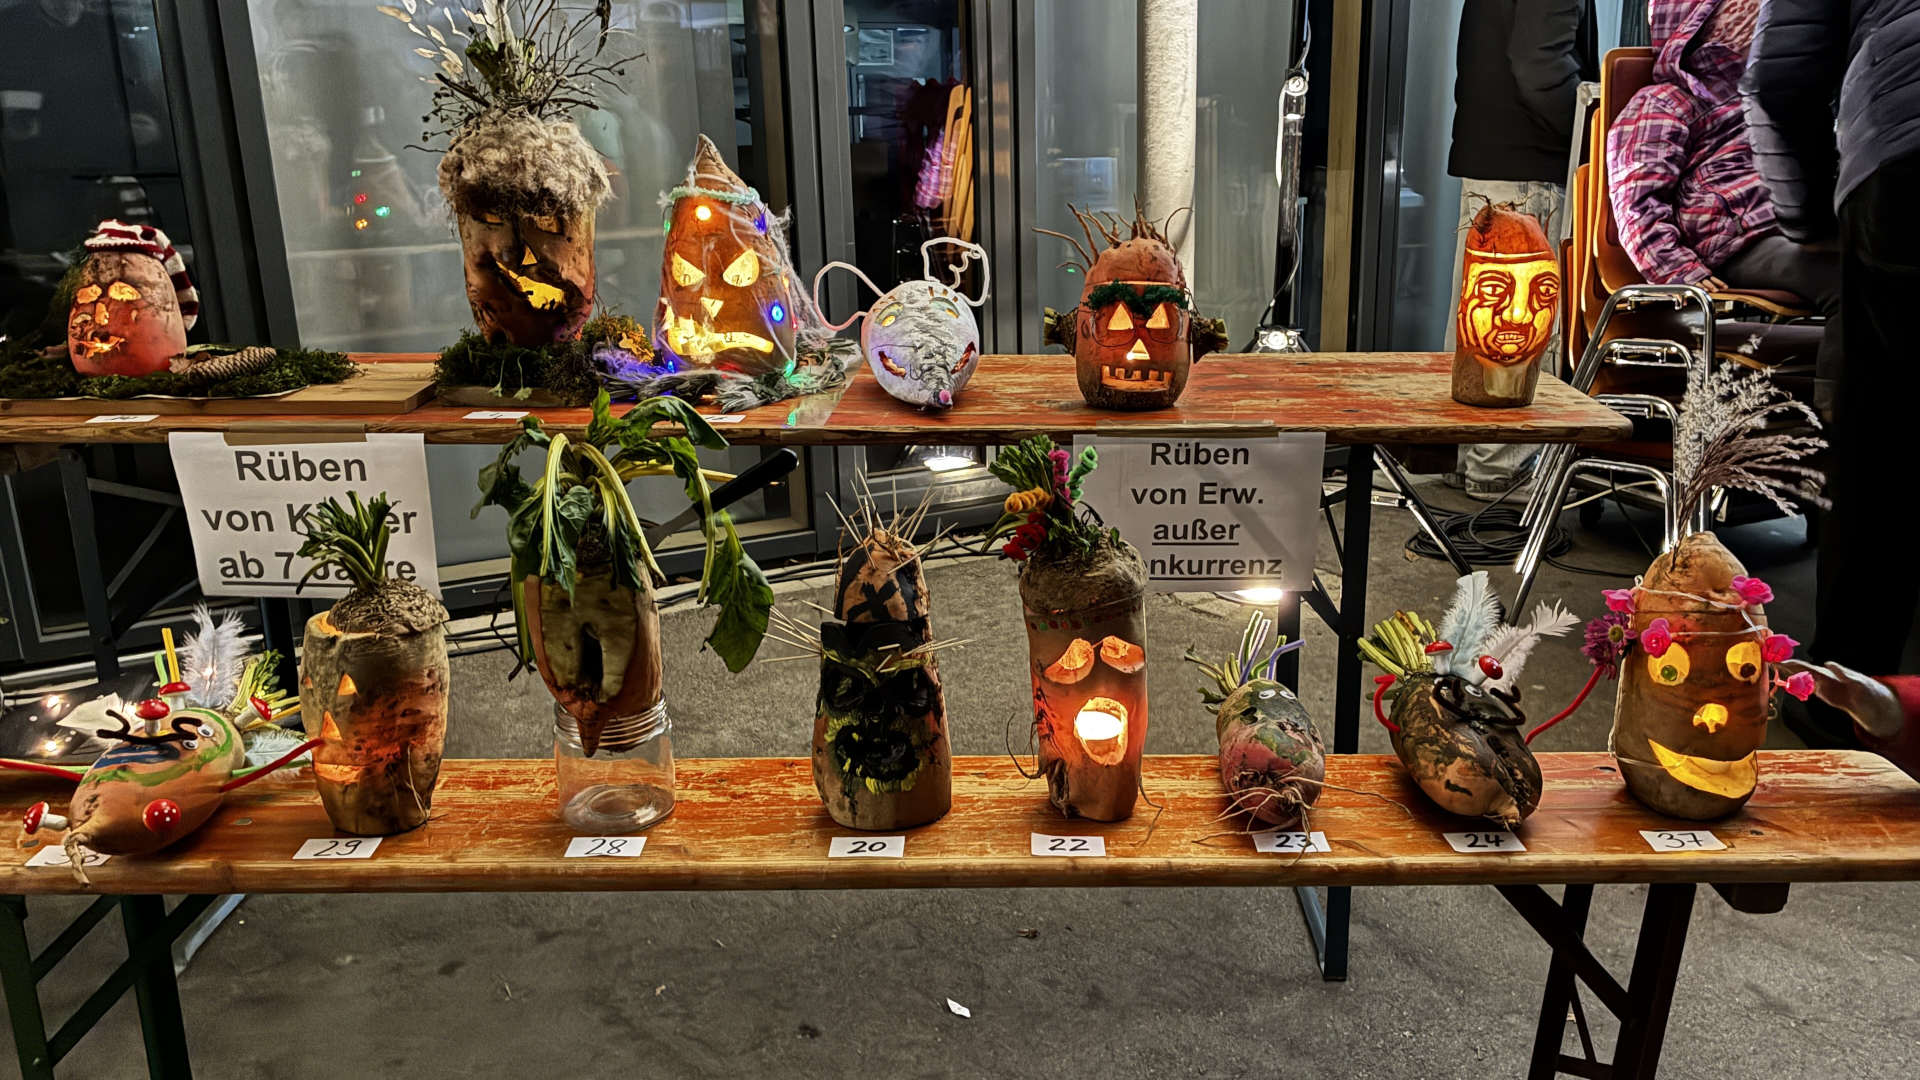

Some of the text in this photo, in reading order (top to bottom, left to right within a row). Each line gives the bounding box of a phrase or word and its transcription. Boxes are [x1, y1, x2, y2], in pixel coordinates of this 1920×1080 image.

[1150, 442, 1249, 465] Rüben
[234, 450, 367, 482] Rüben
[1131, 482, 1264, 505] von Erw.
[201, 503, 418, 534] von Ker
[1152, 518, 1241, 541] außer
[219, 551, 265, 580] ab
[274, 552, 295, 580] 7
[312, 839, 363, 857] 29
[584, 838, 629, 856] 28
[846, 840, 887, 854] 20
[1049, 838, 1090, 851] 22
[1275, 834, 1313, 848] 23
[1464, 834, 1504, 848] 24
[1657, 832, 1704, 849] 37
